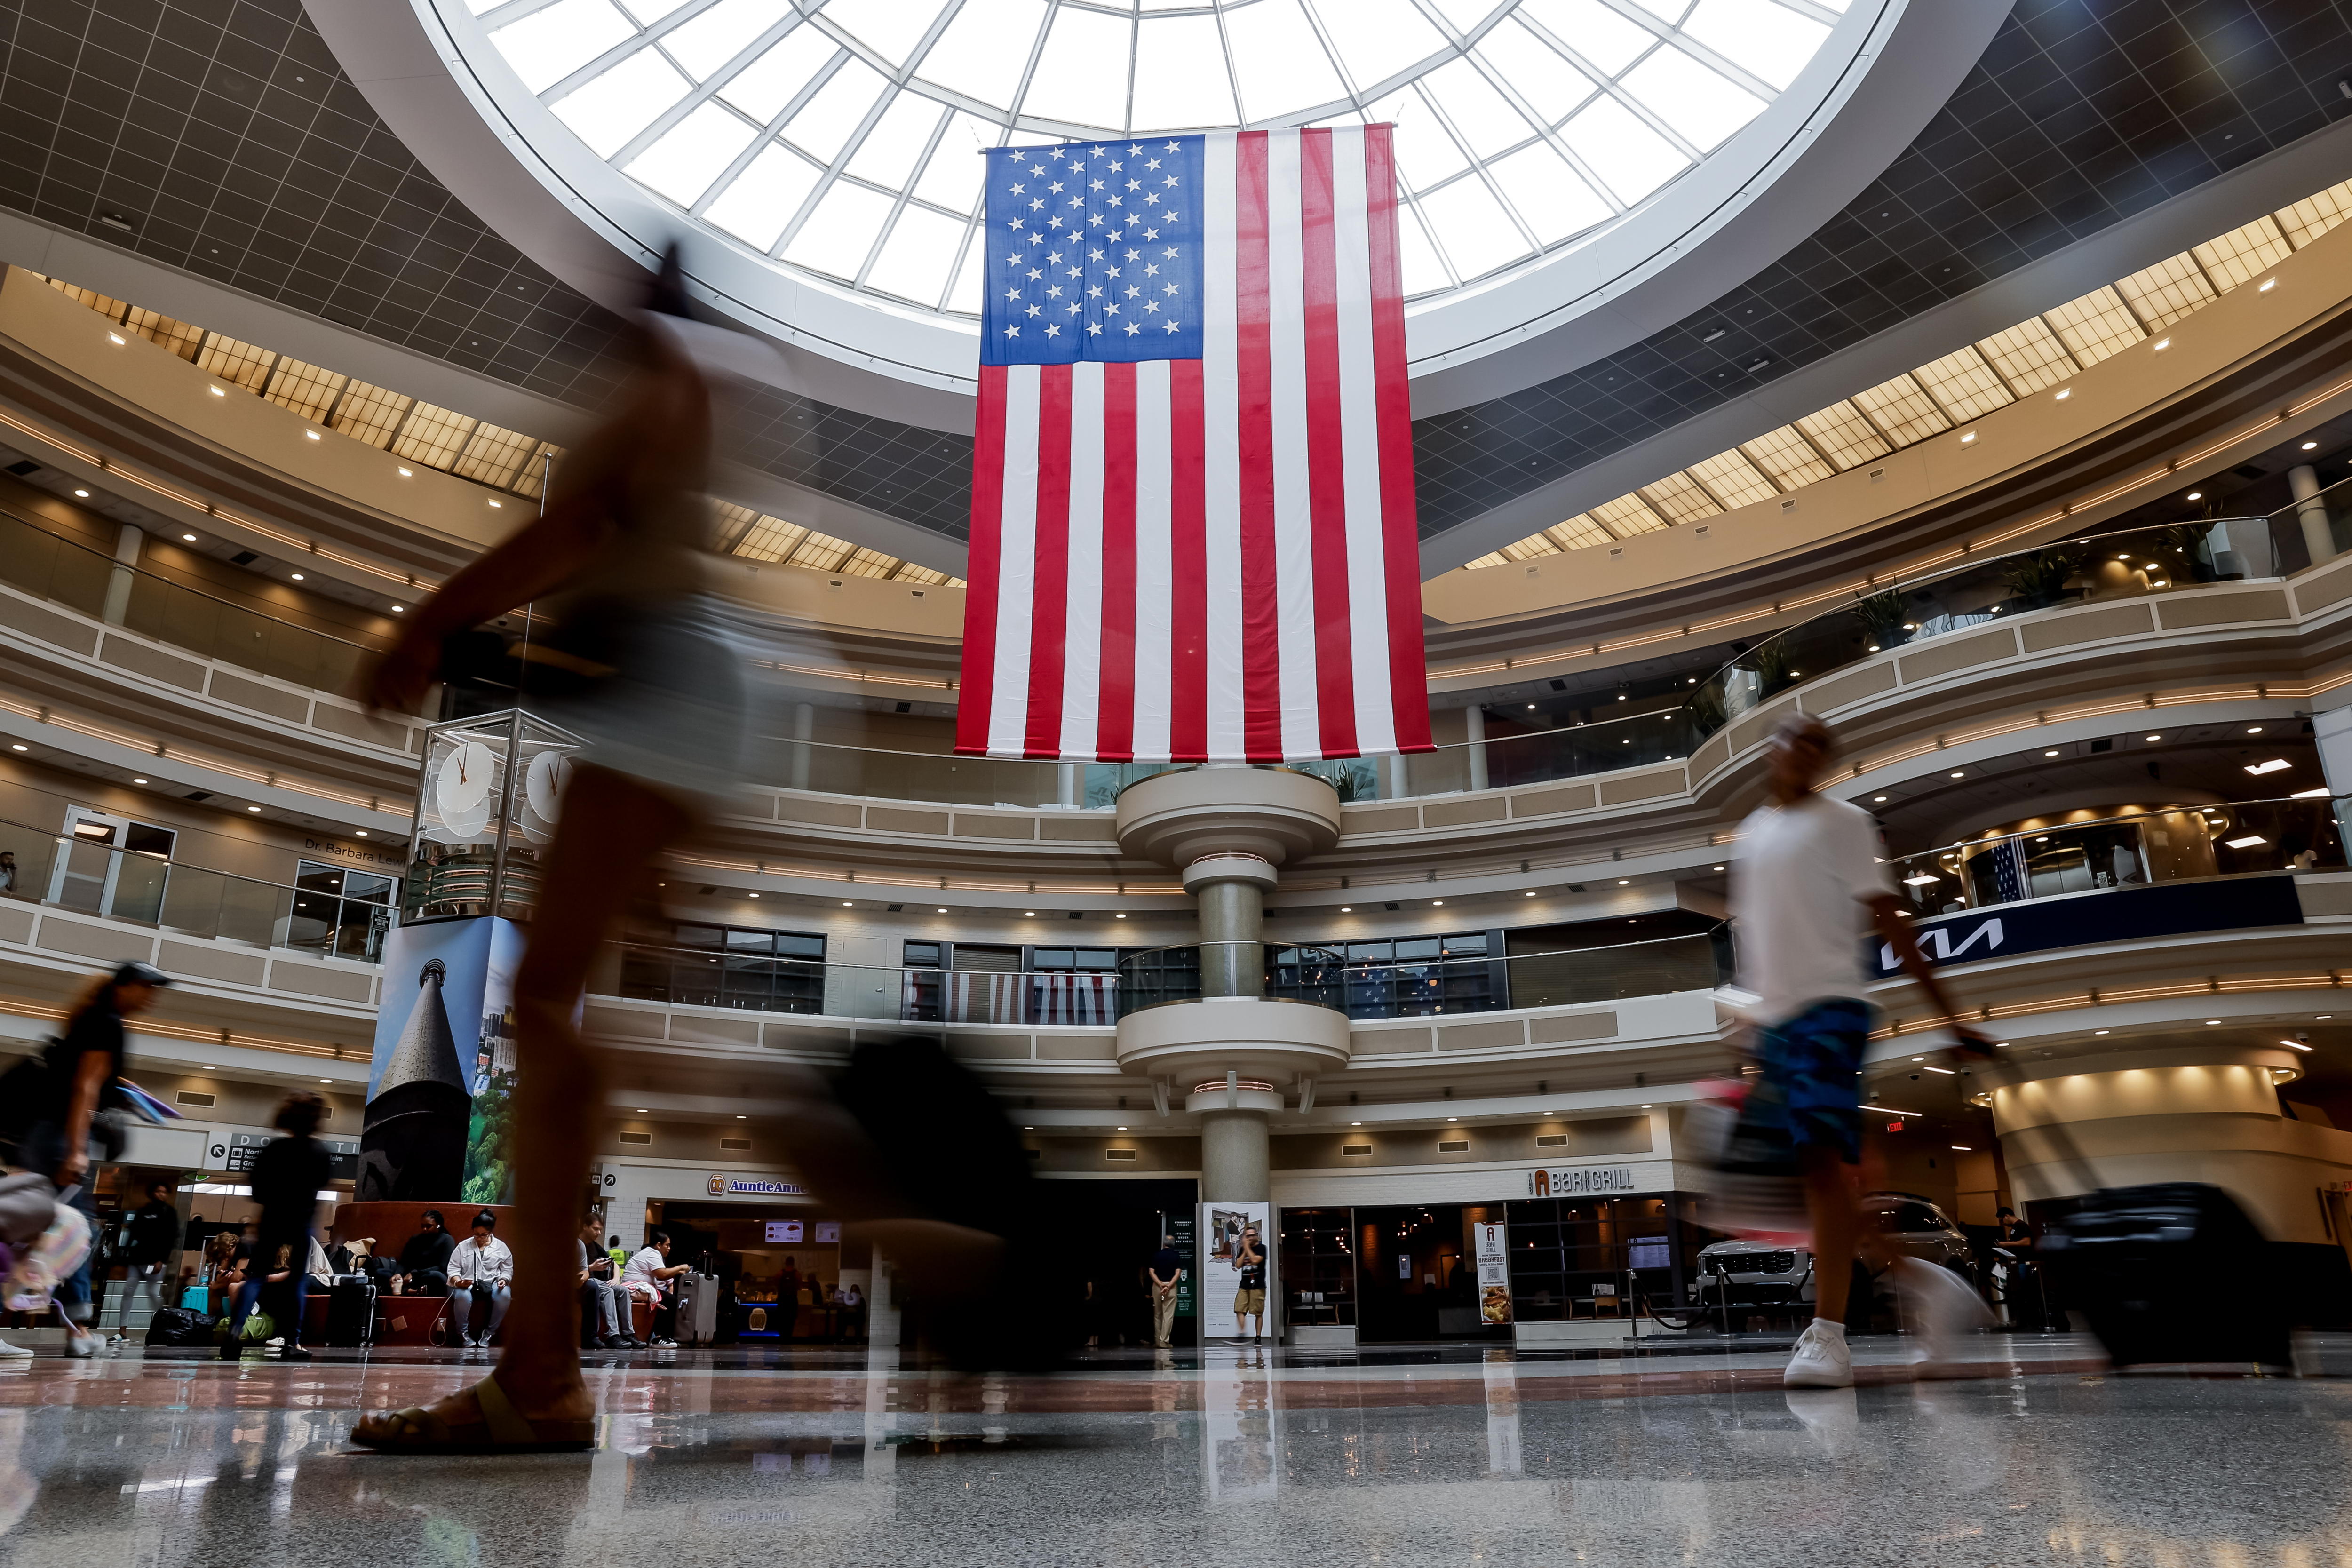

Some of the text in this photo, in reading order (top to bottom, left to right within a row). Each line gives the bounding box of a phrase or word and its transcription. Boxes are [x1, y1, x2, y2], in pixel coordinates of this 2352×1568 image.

[306, 838, 406, 868] Dr. Barbara Lewi
[1890, 1122, 1902, 1132] EXIT
[1591, 1168, 1635, 1190] GRILL
